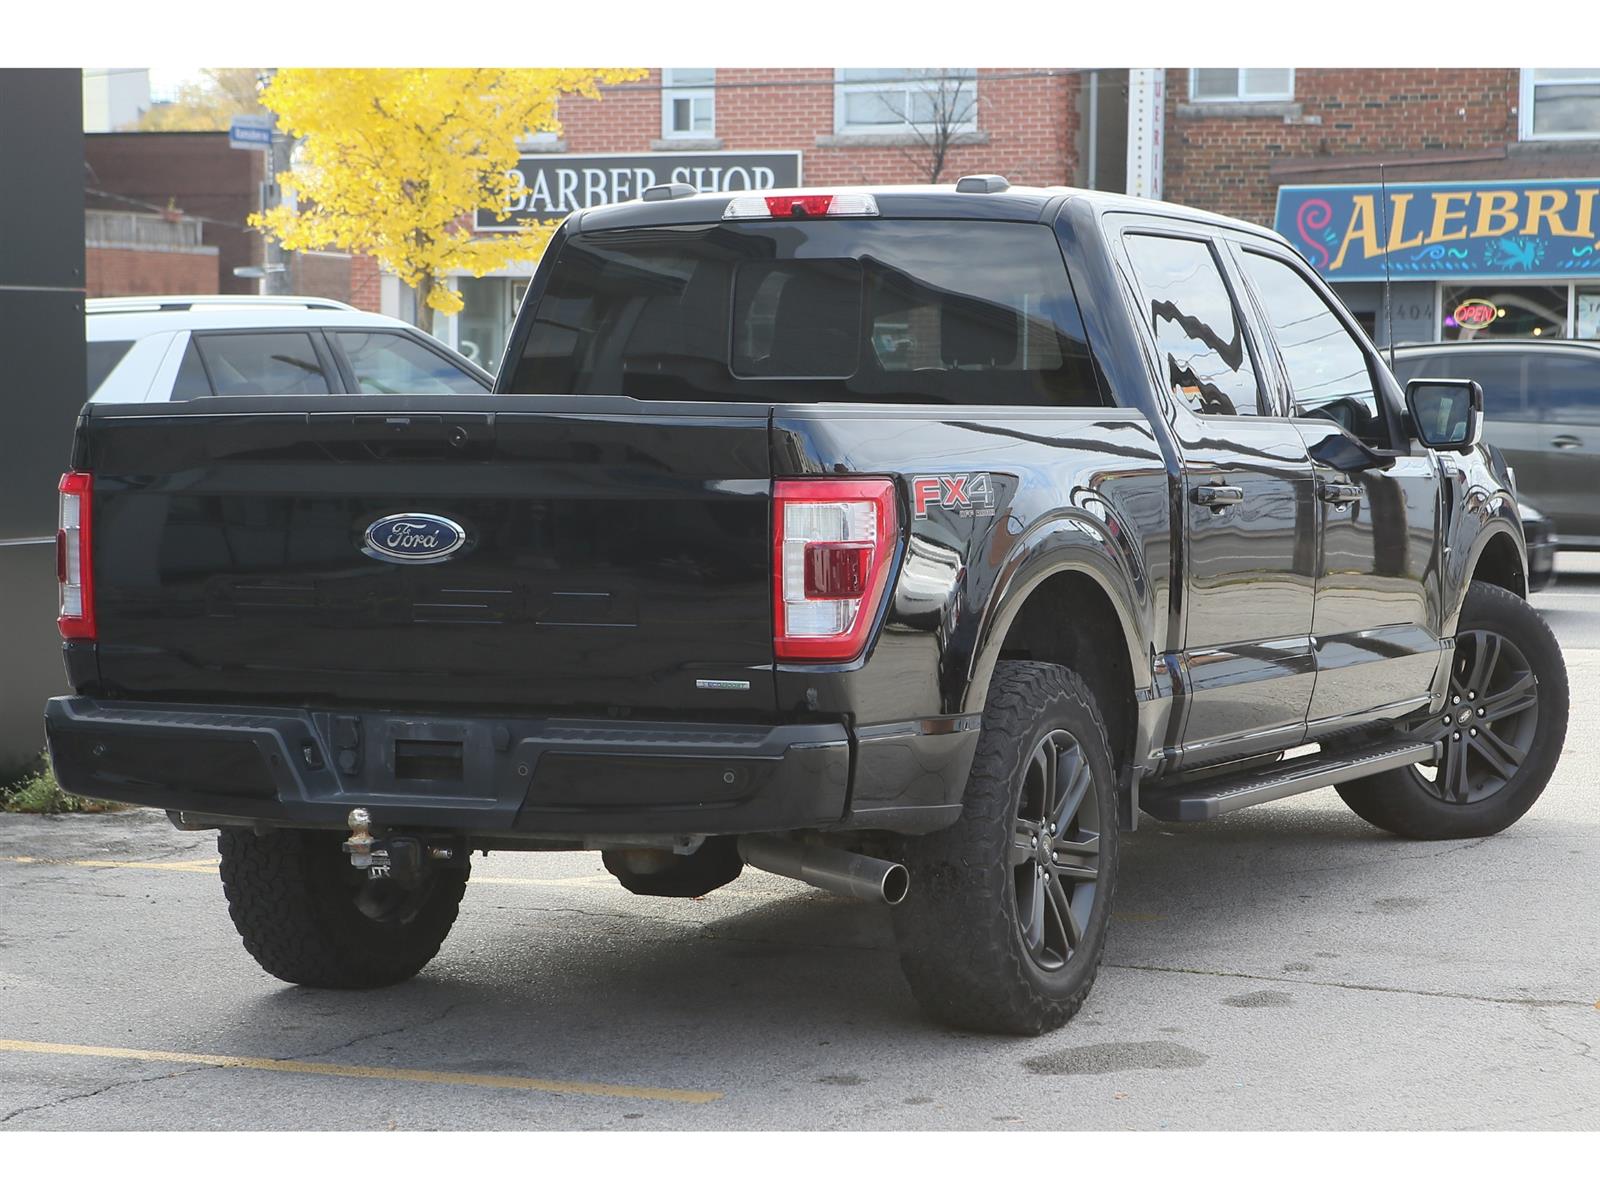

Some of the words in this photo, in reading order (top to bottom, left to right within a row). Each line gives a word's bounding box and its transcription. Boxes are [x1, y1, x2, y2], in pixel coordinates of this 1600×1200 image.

[503, 168, 656, 212] BARBER
[1329, 188, 1600, 270] ALEBRI
[1456, 305, 1493, 323] OPEN
[911, 473, 995, 520] FX4
[387, 522, 440, 548] Ford
